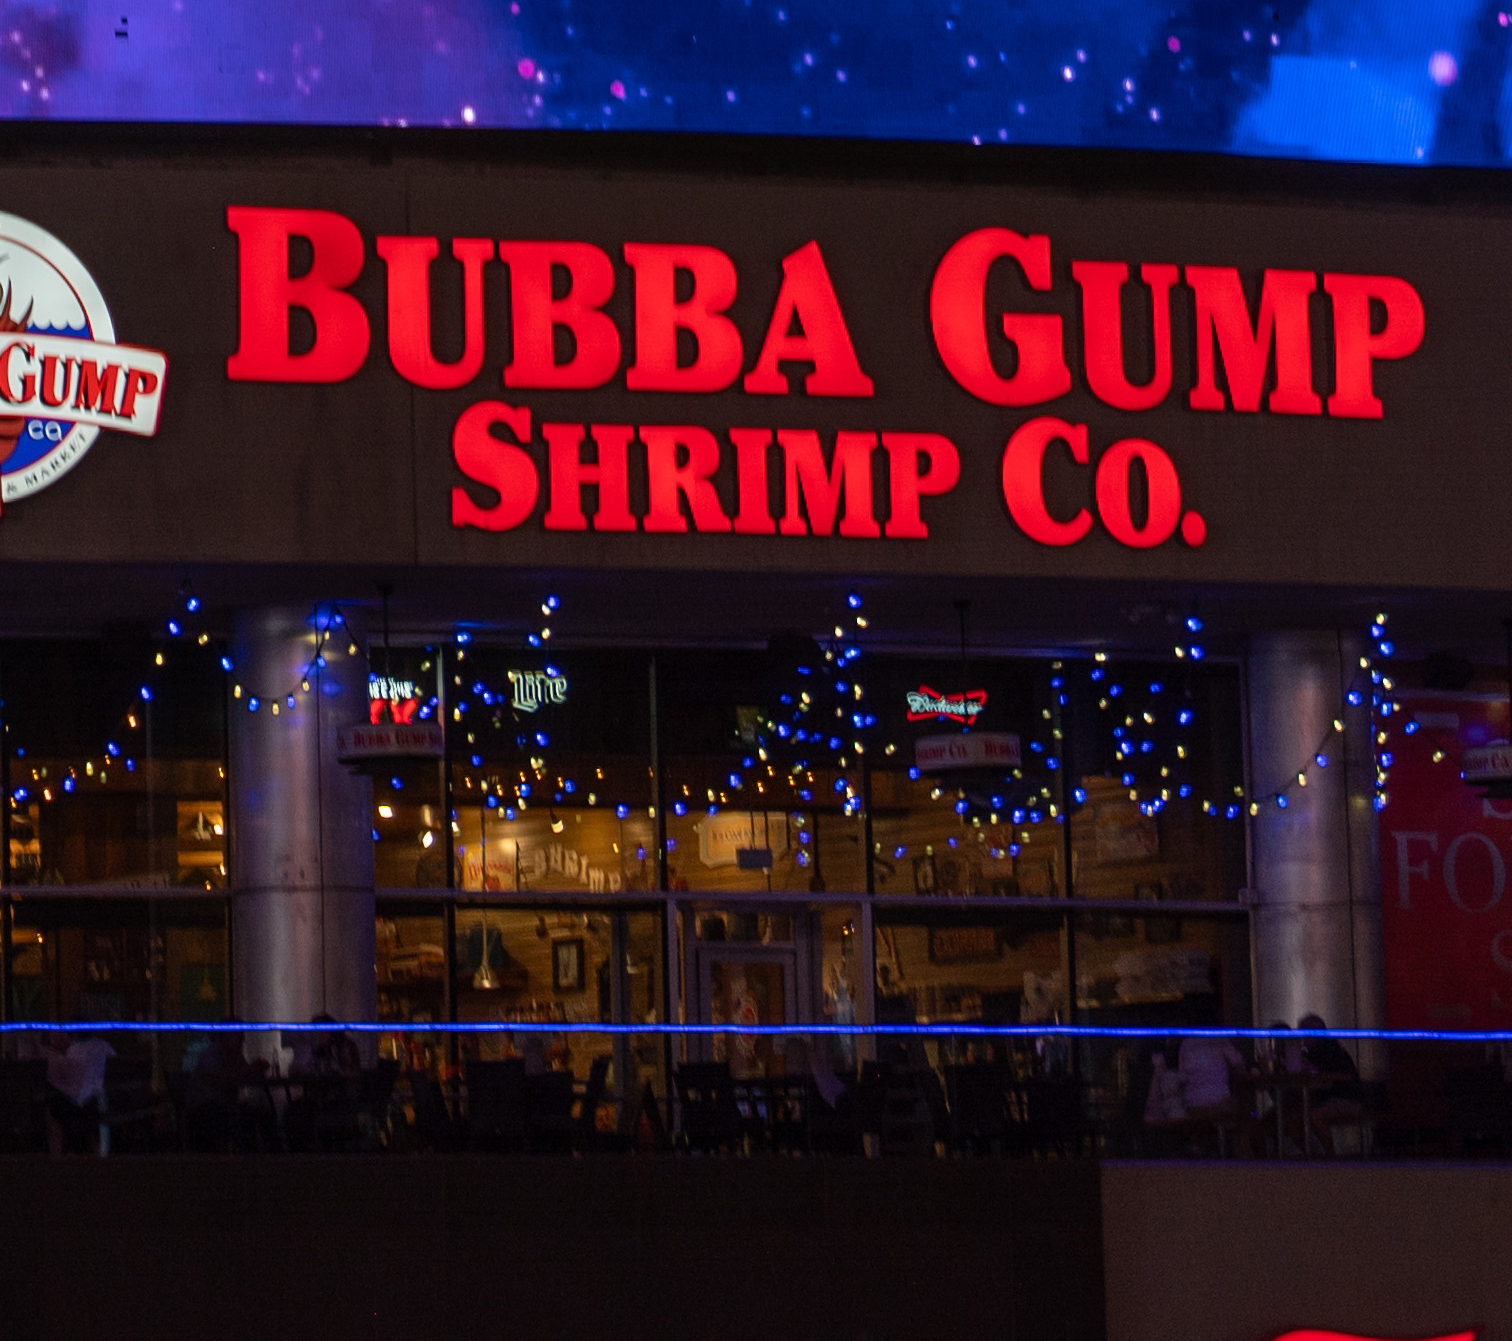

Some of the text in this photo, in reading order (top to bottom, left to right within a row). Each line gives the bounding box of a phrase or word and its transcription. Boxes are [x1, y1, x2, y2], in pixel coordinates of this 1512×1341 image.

[225, 205, 1428, 422] BUBBA GUMP
[23, 430, 89, 489] MARKET
[449, 402, 1208, 549] SHRIMP CO.
